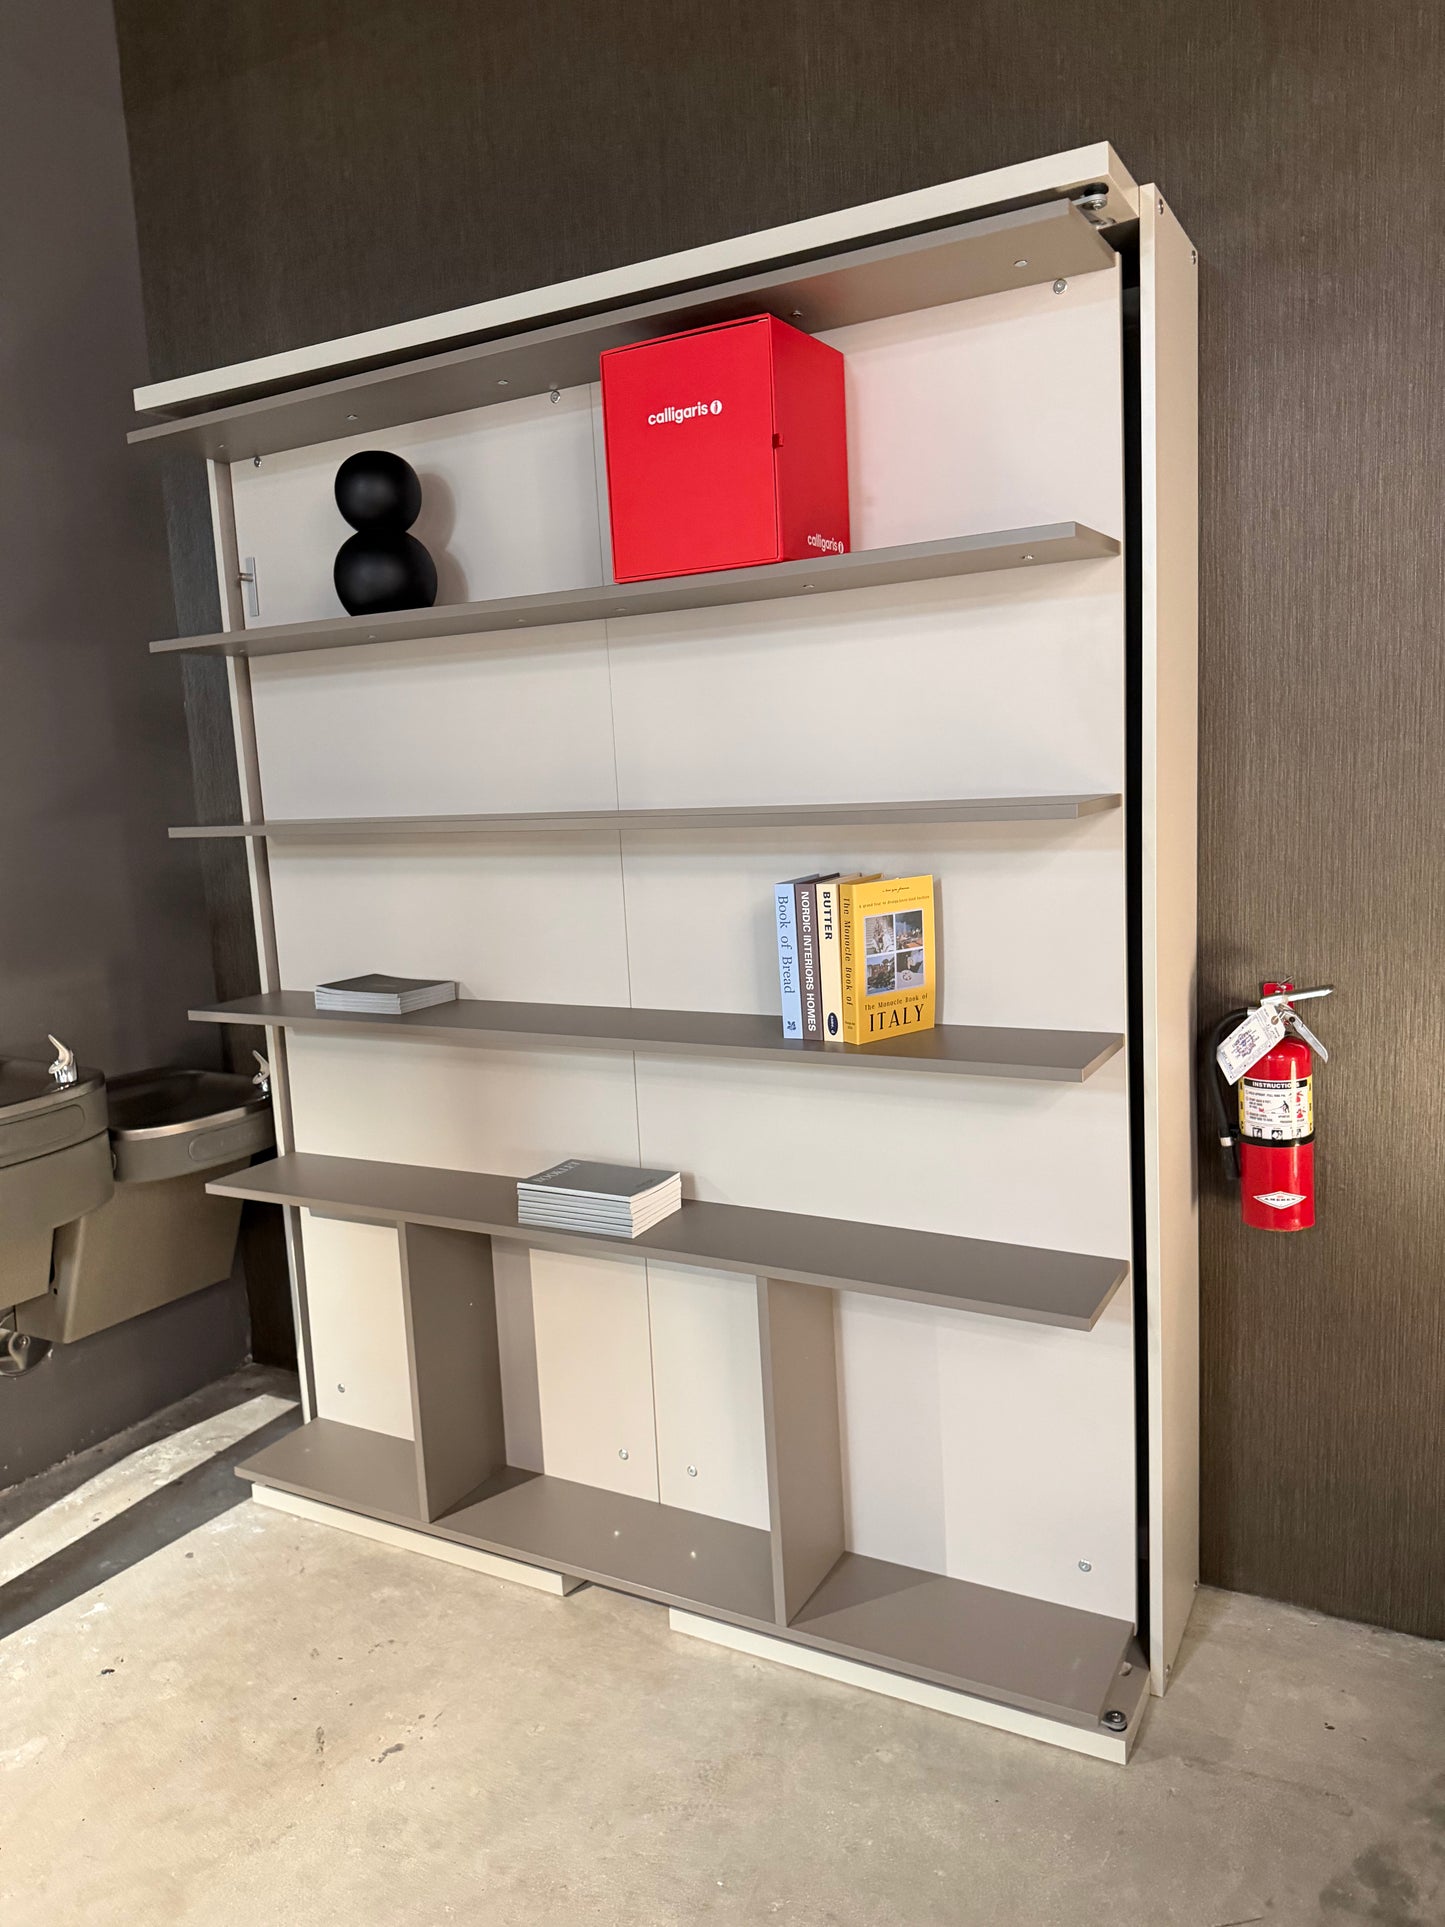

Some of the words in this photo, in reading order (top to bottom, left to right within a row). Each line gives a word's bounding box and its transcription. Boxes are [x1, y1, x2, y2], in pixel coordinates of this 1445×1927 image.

[648, 401, 708, 425] calligaris
[807, 533, 838, 552] calligaris
[778, 895, 791, 929] Book
[800, 891, 811, 933] NORDIC
[822, 891, 833, 940] BUTTER
[780, 936, 793, 950] of
[781, 956, 796, 994] Bread
[803, 935, 815, 991] INTERIORS
[845, 967, 853, 990] Book
[806, 993, 817, 1032] HOMES
[846, 995, 853, 1006] of
[878, 999, 902, 1008] Monocle
[905, 995, 919, 1003] Book
[870, 1003, 924, 1032] ITALY
